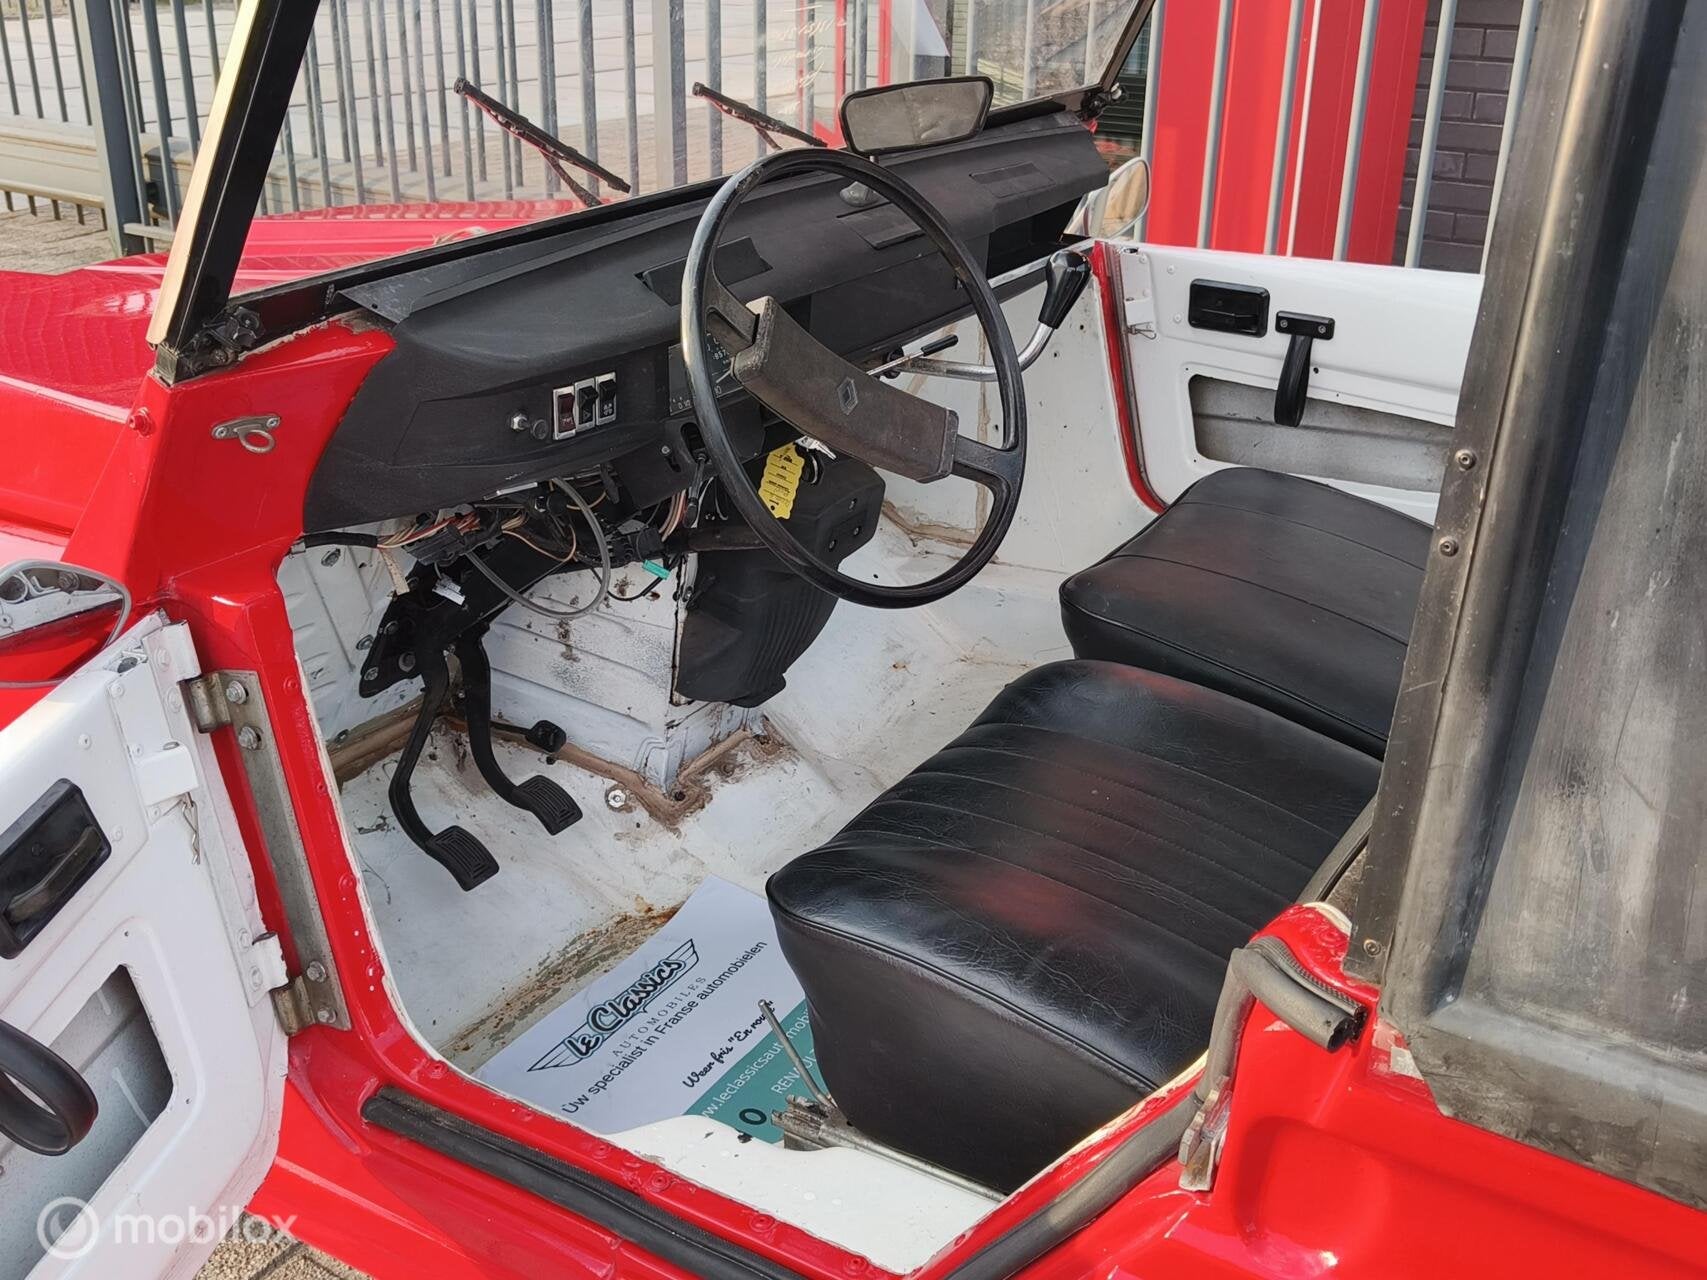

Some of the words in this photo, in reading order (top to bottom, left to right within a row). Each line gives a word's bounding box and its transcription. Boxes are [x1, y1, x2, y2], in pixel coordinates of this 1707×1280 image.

[588, 1043, 648, 1096] specialist
[643, 1035, 659, 1047] in
[654, 1000, 699, 1036] Franse
[696, 940, 768, 1001] automobielen
[590, 961, 683, 1032] Classics
[612, 976, 706, 1057] AUTOMOBILES
